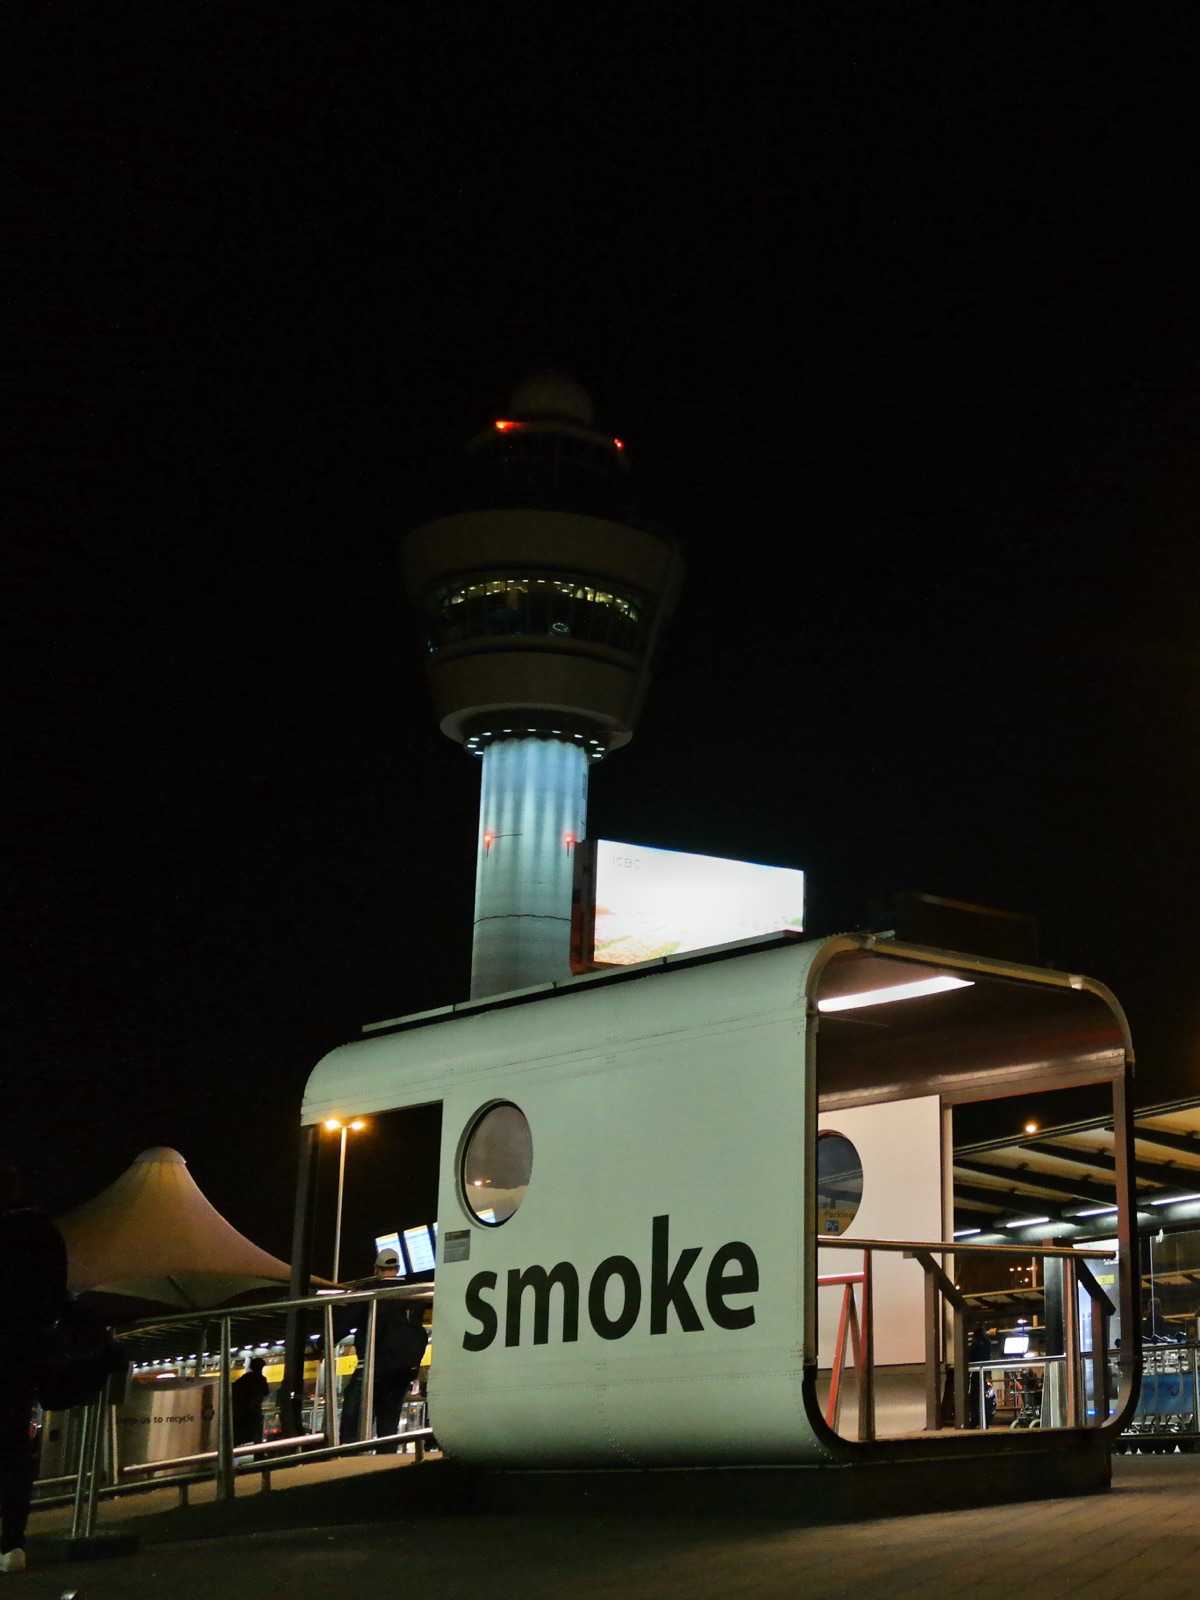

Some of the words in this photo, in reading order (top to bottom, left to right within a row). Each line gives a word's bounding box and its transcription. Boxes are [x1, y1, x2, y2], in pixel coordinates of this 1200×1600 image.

[612, 855, 641, 870] ICBC
[825, 1209, 855, 1221] Parking
[462, 1214, 759, 1352] smoke
[165, 1414, 195, 1425] recycle
